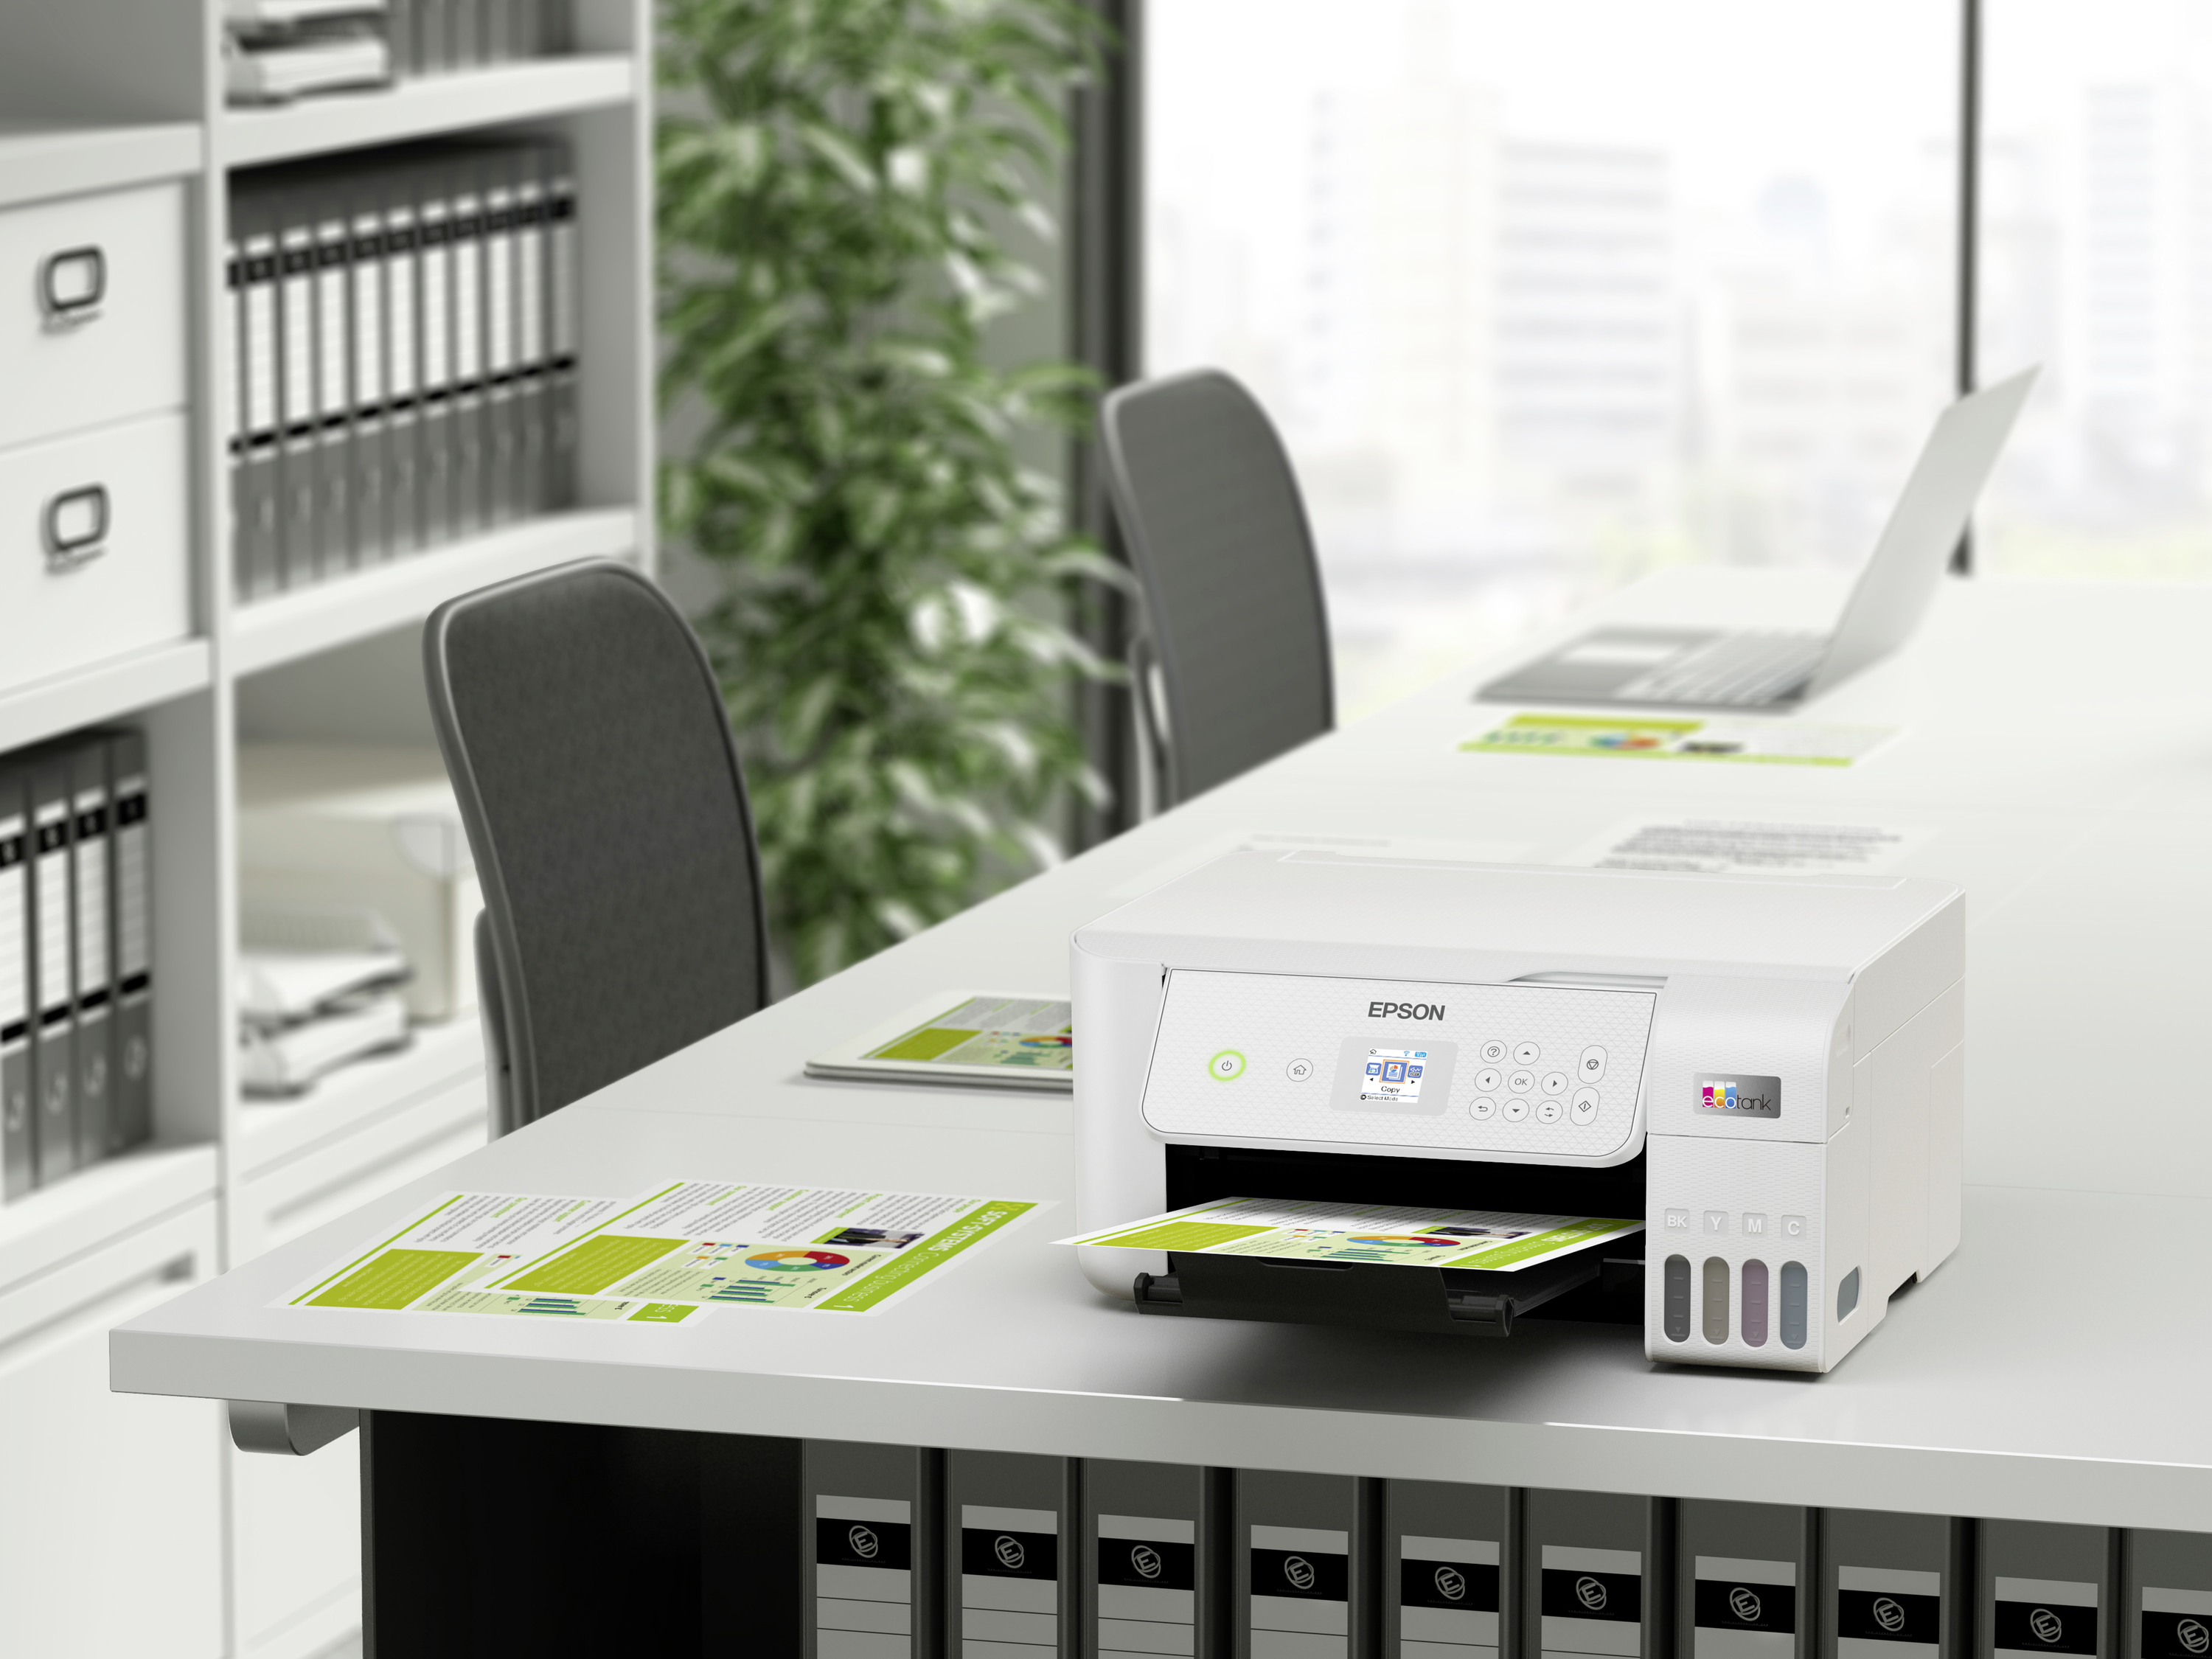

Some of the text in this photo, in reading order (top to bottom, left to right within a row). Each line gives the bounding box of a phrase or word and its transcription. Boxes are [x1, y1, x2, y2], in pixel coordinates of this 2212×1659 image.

[1368, 1001, 1445, 1020] EPSON
[1381, 1085, 1400, 1093] Copy
[1514, 1078, 1528, 1086] OK
[1703, 1094, 1771, 1110] ecotank
[1667, 1215, 1687, 1228] BK
[1710, 1217, 1722, 1231] Y
[1748, 1219, 1761, 1233] M
[1787, 1221, 1800, 1235] C
[927, 1210, 1008, 1252] SOFT-SYSTEMS
[875, 1252, 940, 1282] Connecting
[843, 1279, 889, 1303] business
